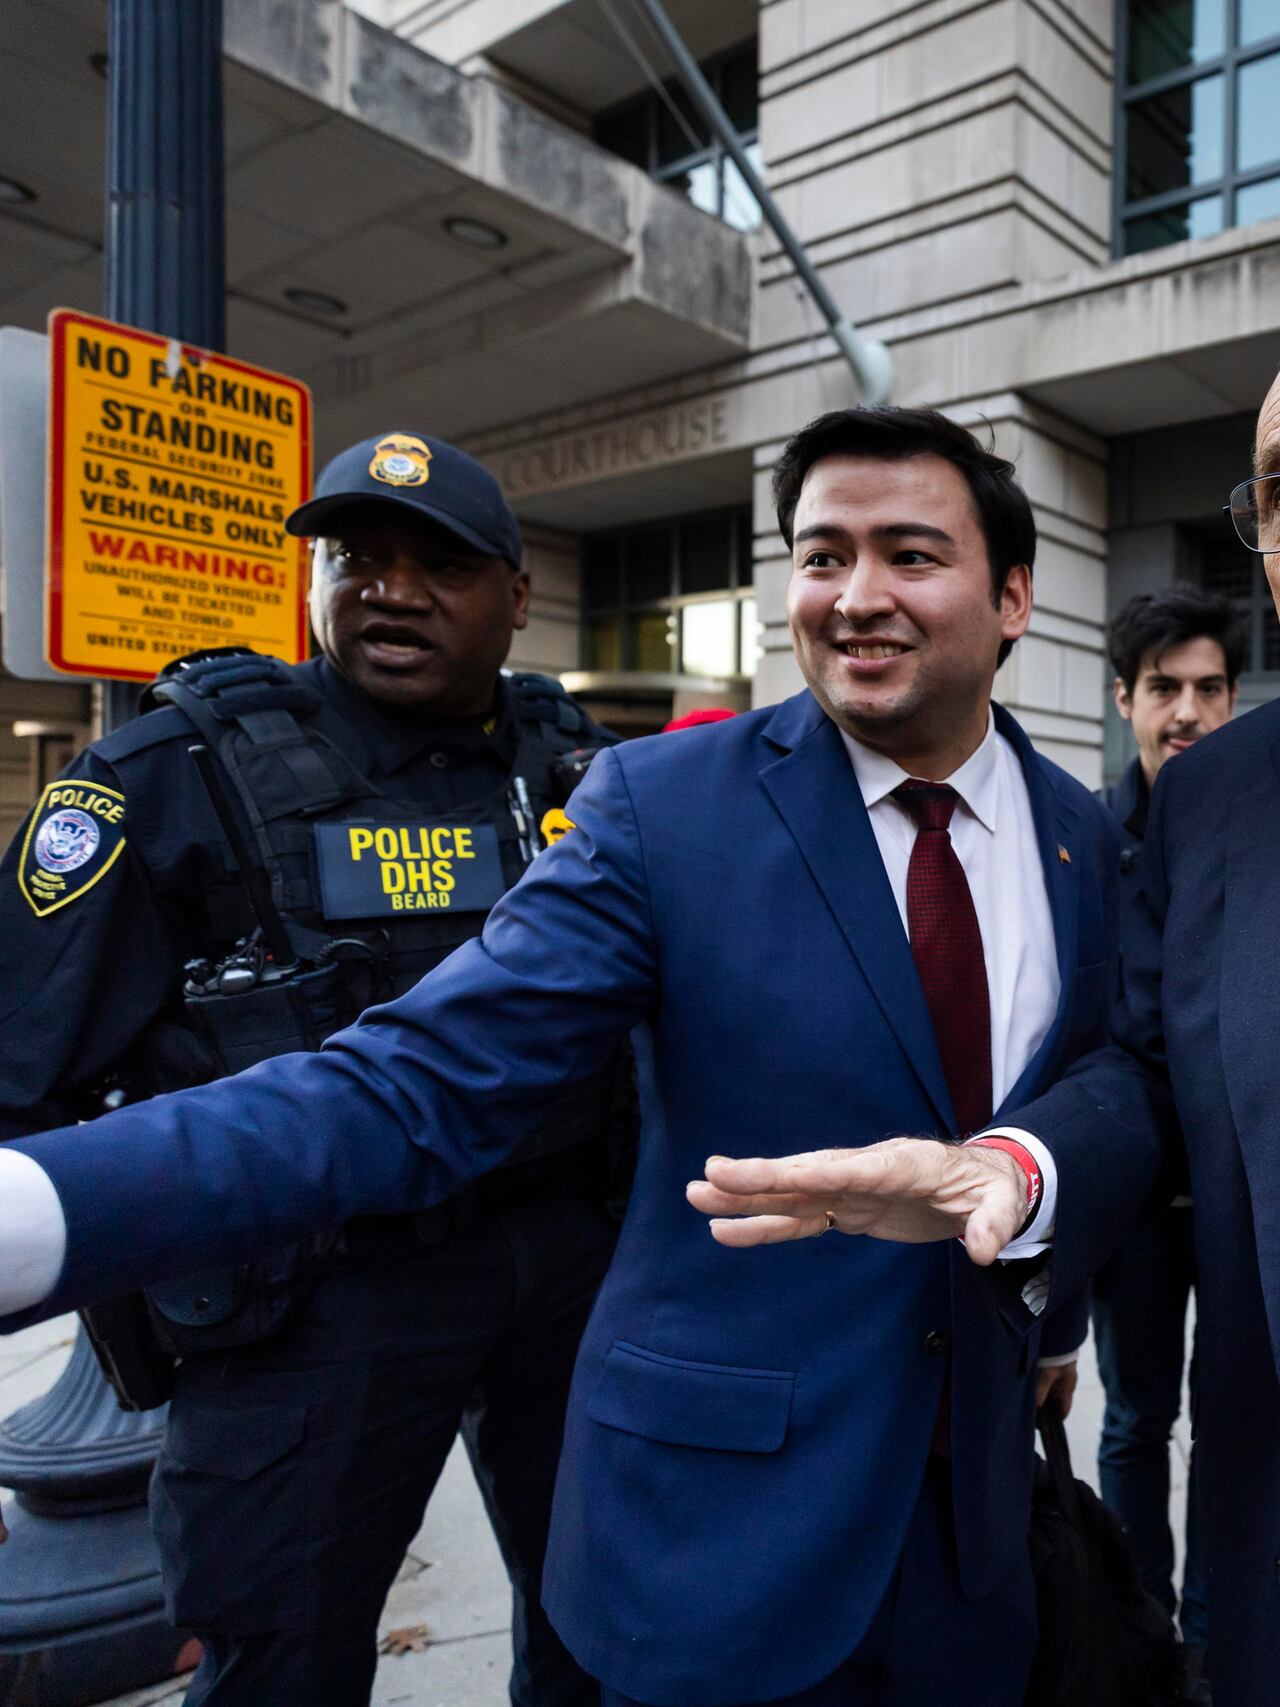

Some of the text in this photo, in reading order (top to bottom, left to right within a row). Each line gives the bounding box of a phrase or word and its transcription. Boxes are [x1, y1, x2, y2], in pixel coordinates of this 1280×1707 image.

[77, 336, 294, 426] NO PARKING
[179, 401, 208, 419] OR
[86, 431, 161, 461] FEDERAL
[168, 451, 242, 477] SECURITY
[101, 398, 274, 470] STANDING
[502, 401, 727, 491] COURTHOUSE
[84, 461, 285, 523] U.S. MARSHALS
[80, 489, 286, 549] VEHICLES ONLY
[88, 531, 287, 589] WARNING:
[83, 561, 281, 605] UNAUTHORIZED VEHICLES
[116, 584, 257, 617] WILL BE TICKETED
[141, 605, 234, 629] AND TOWED
[86, 633, 146, 651] UNITED
[48, 788, 126, 824] POLICE
[349, 827, 476, 861] POLICE
[380, 860, 456, 894] DHS
[391, 891, 450, 911] BEARD
